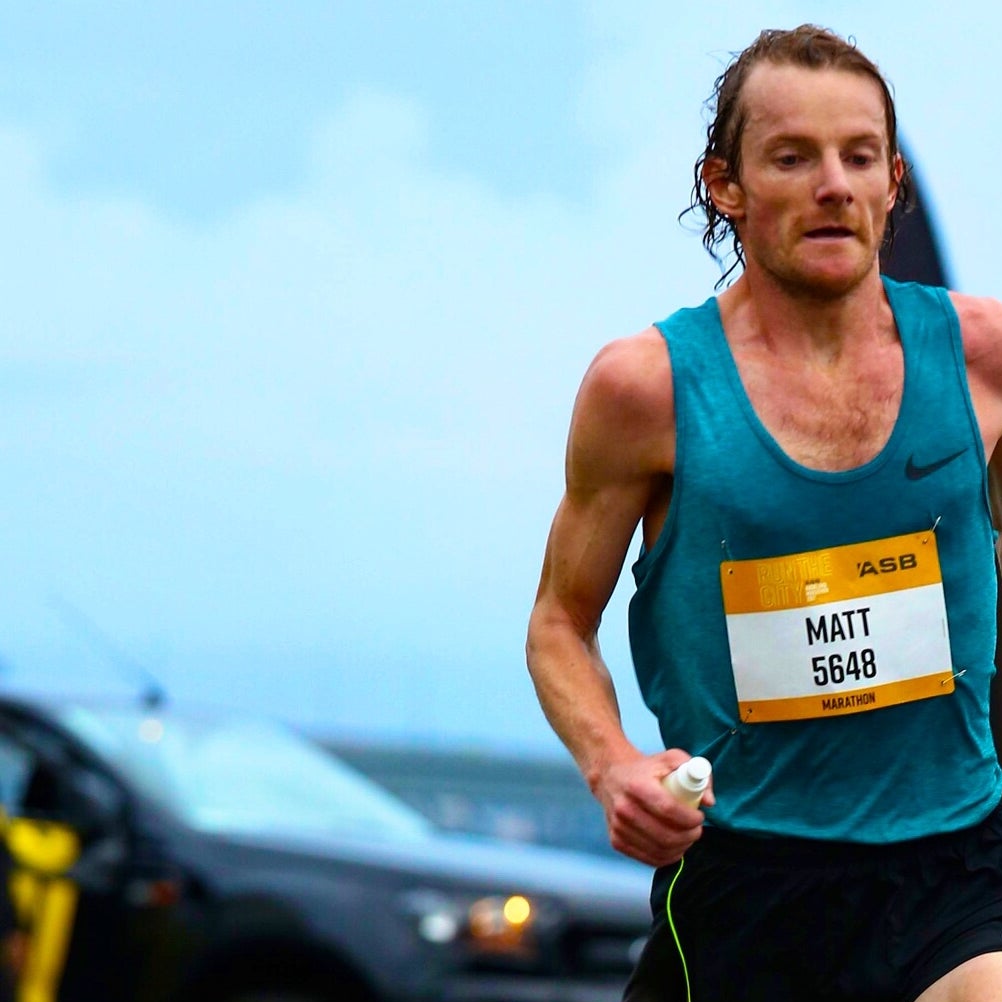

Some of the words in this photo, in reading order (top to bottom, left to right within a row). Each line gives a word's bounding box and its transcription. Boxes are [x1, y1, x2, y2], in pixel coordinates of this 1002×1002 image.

[757, 559, 797, 585] RUN
[798, 552, 833, 577] THE
[857, 553, 918, 577] ASB
[759, 582, 806, 608] CITY
[805, 607, 871, 646] MATT
[811, 648, 877, 687] 5648
[822, 692, 876, 711] MARATHON
